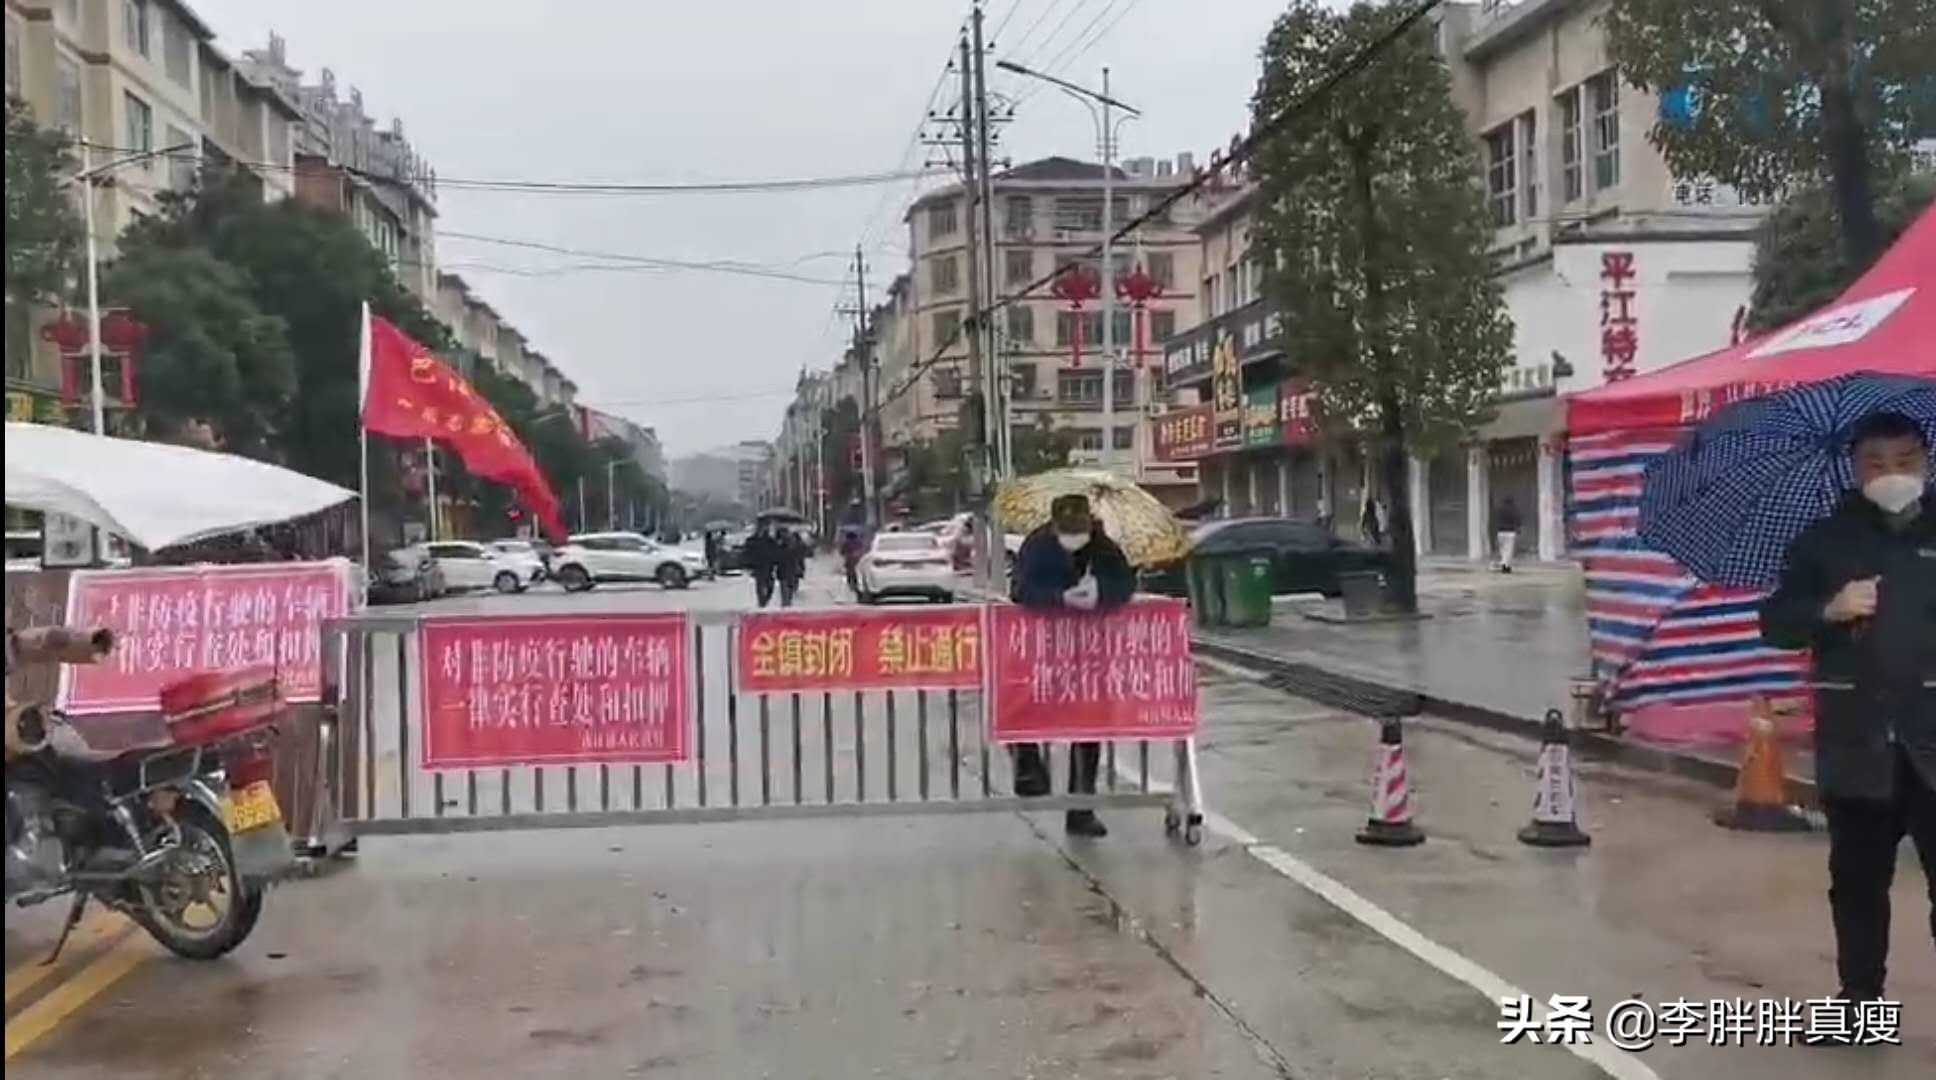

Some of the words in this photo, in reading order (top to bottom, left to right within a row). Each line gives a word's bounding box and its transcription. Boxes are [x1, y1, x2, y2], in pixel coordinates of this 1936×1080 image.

[440, 634, 670, 685] 对非防疫行驶的车辆
[751, 627, 855, 678] 全镇封闭
[877, 623, 978, 677] 禁止通行
[441, 681, 669, 730] 一律实行查处和扣押
